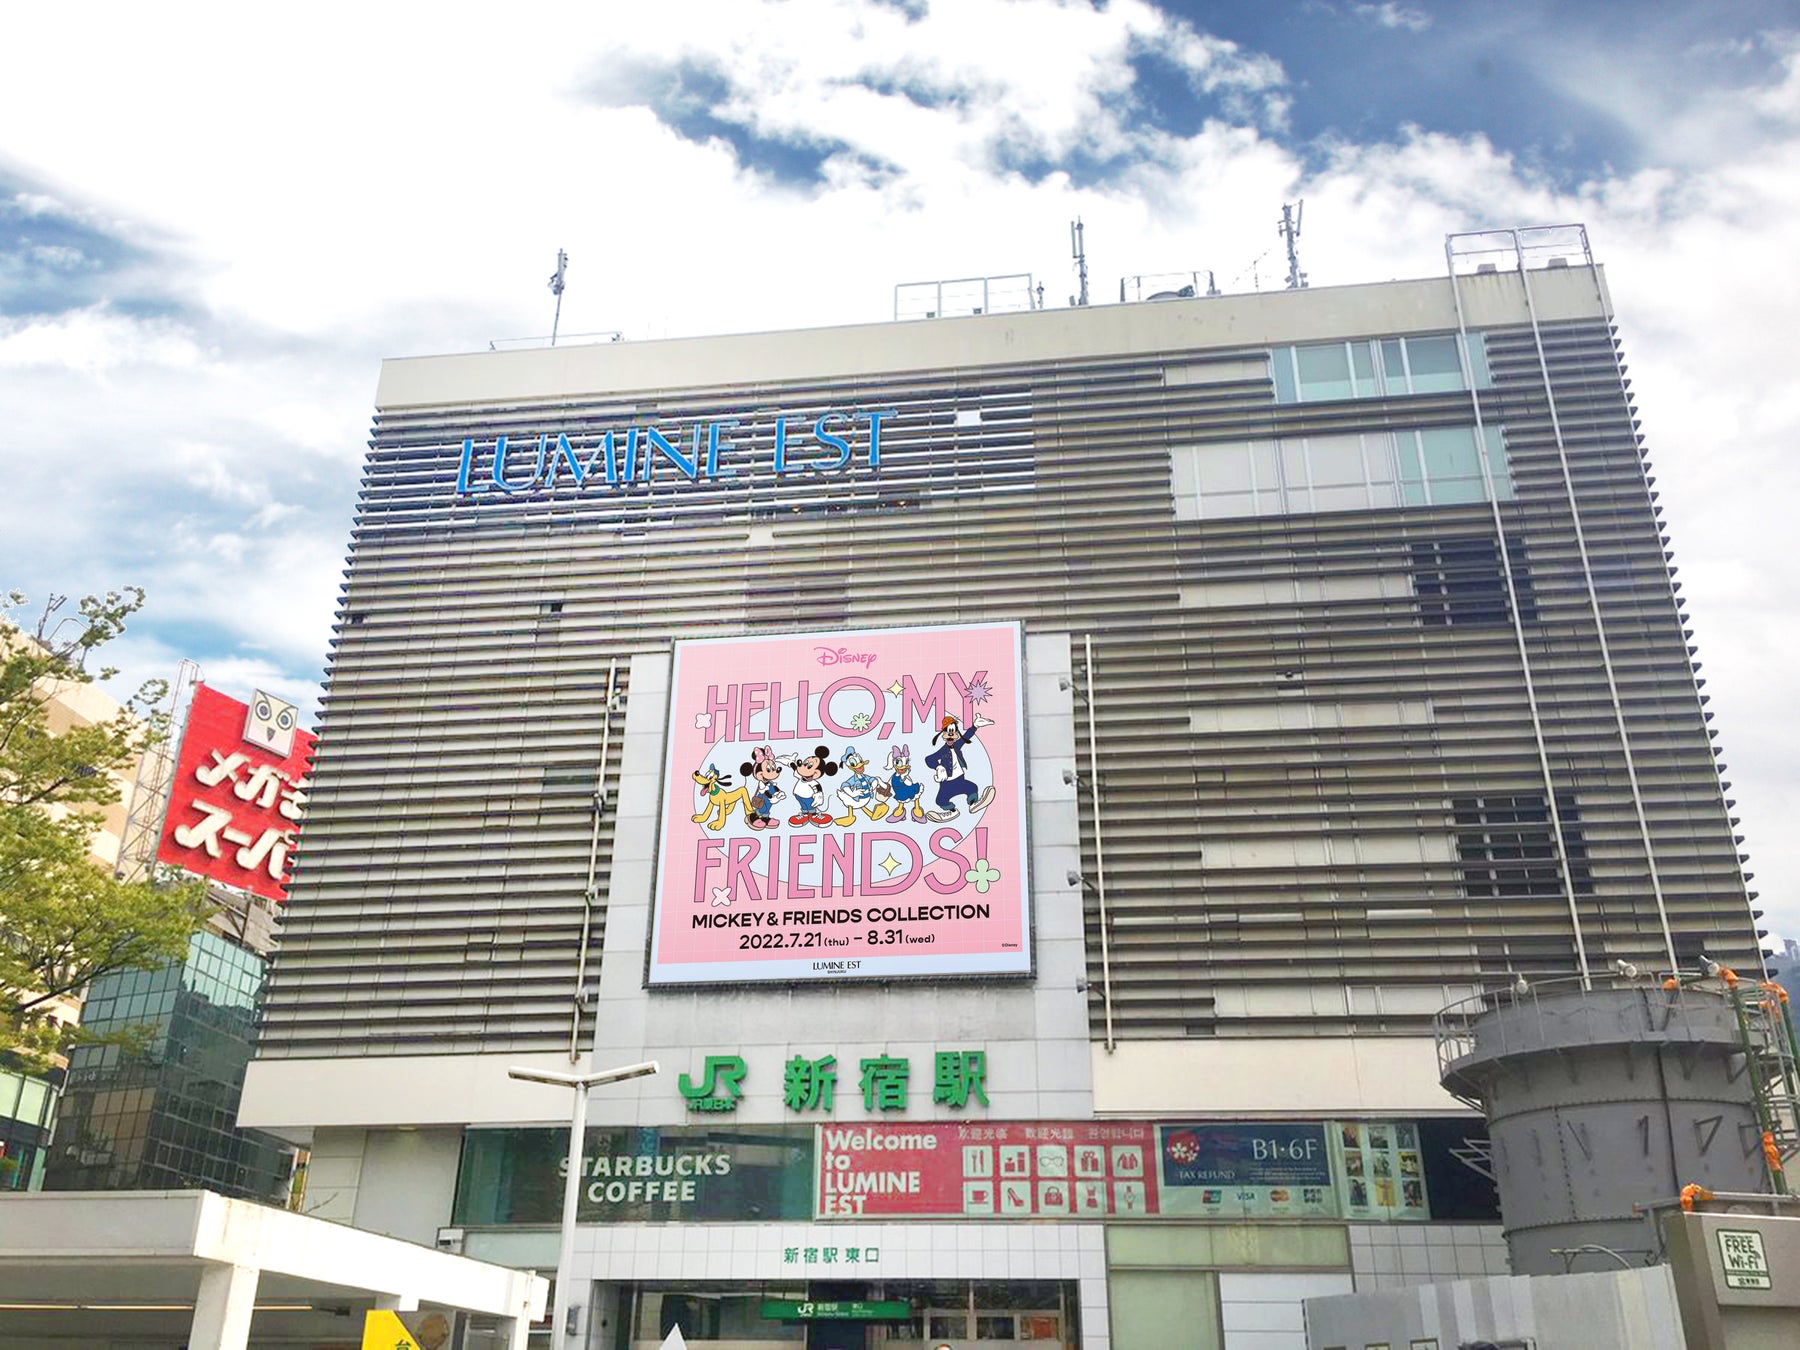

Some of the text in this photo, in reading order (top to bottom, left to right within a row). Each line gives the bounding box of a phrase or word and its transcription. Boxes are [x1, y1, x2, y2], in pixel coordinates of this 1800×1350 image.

[456, 408, 899, 494] LUMINE EST
[704, 670, 989, 744] HELLO, MY
[693, 827, 993, 903] FRIENDS!
[692, 903, 990, 929] MICKEY & FRIENDS COLLECTION
[812, 960, 862, 971] LUMINE EST
[678, 1050, 990, 1113] JR 新宿駅
[825, 1129, 938, 1151] Welcome
[825, 1151, 850, 1170] to
[825, 1171, 921, 1195] LUMINE
[1178, 1170, 1197, 1180] TAX
[1198, 1169, 1236, 1180] REFUND
[587, 1180, 697, 1203] COFFEE
[825, 1195, 868, 1215] EST
[1725, 1238, 1756, 1254] FREE
[1727, 1253, 1759, 1270] Wi-Fi
[797, 1302, 814, 1314] JR
